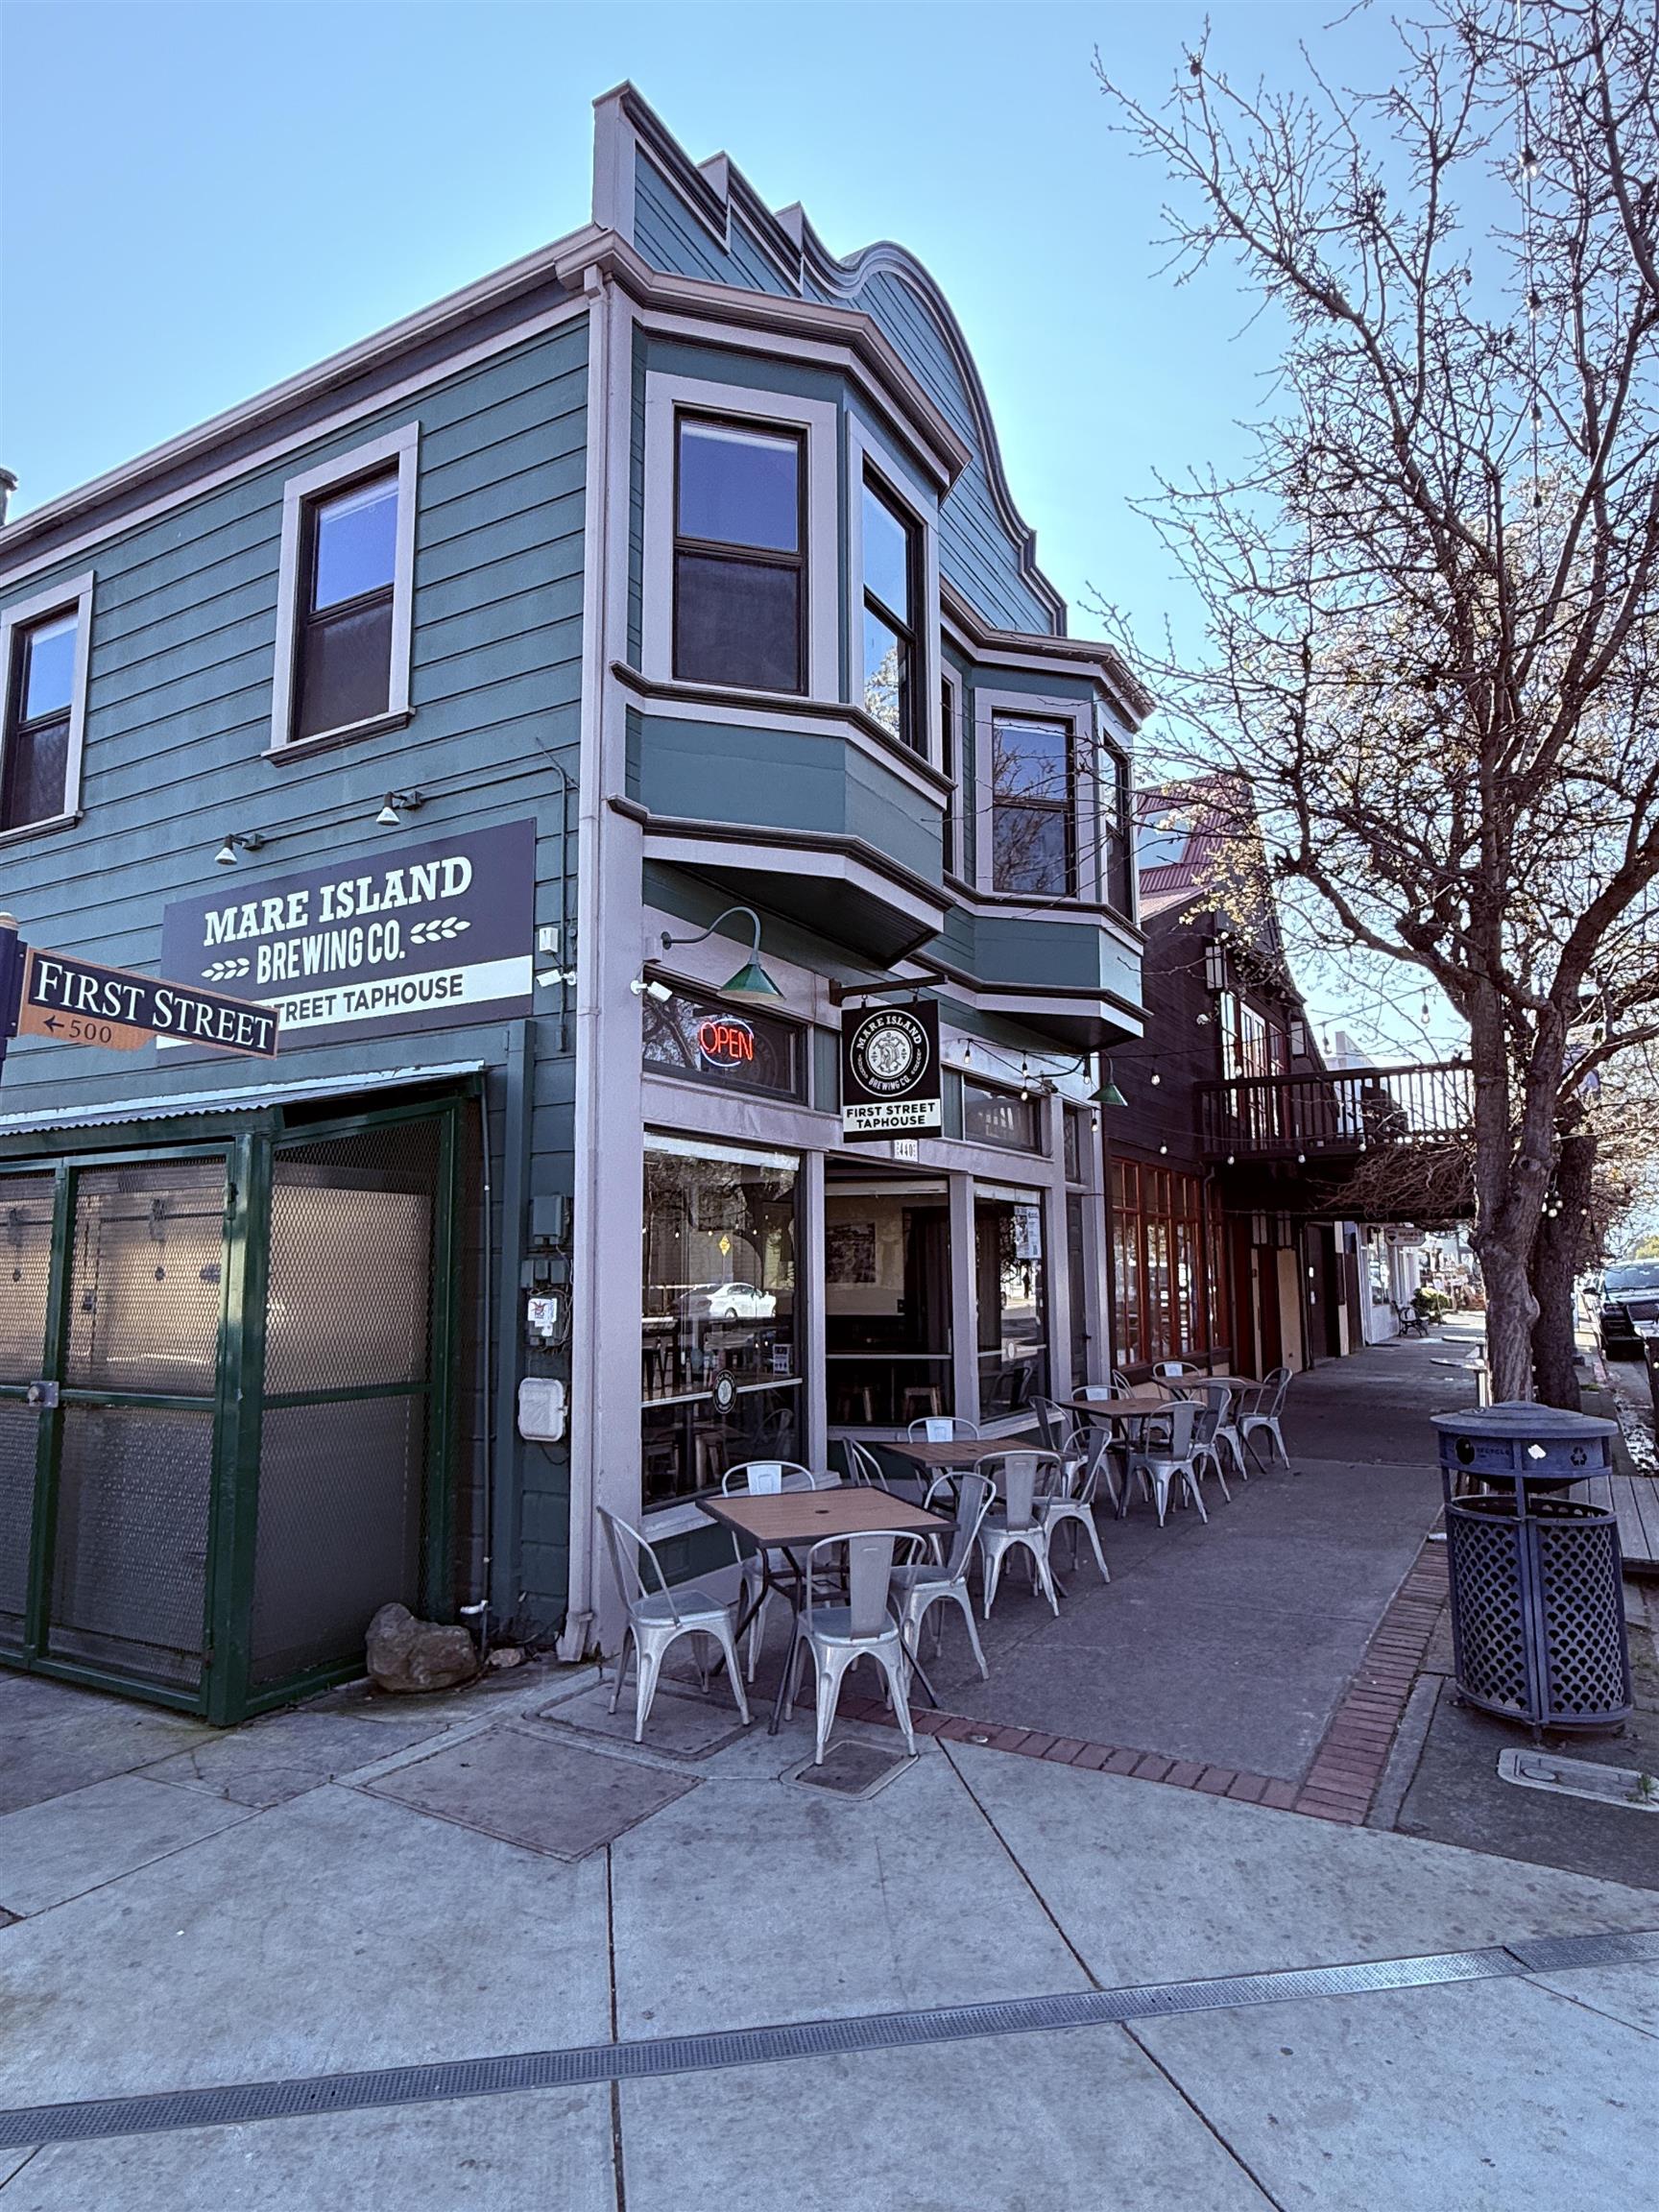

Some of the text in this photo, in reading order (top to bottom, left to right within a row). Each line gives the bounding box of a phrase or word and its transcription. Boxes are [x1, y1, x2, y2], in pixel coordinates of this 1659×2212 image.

[204, 855, 472, 947] MARE ISLAND
[256, 919, 406, 984] BREWING CO.
[34, 960, 274, 1049] FIRST STREET
[267, 974, 463, 1022] TREET TAPHOUSE
[69, 1020, 112, 1044] 500
[700, 1022, 755, 1061] OPEN
[856, 1015, 922, 1049] MARE ISLAND
[869, 1075, 912, 1091] BREWING CO.
[847, 1102, 935, 1118] FIRST STREET
[856, 1115, 926, 1129] TAPHOUSE
